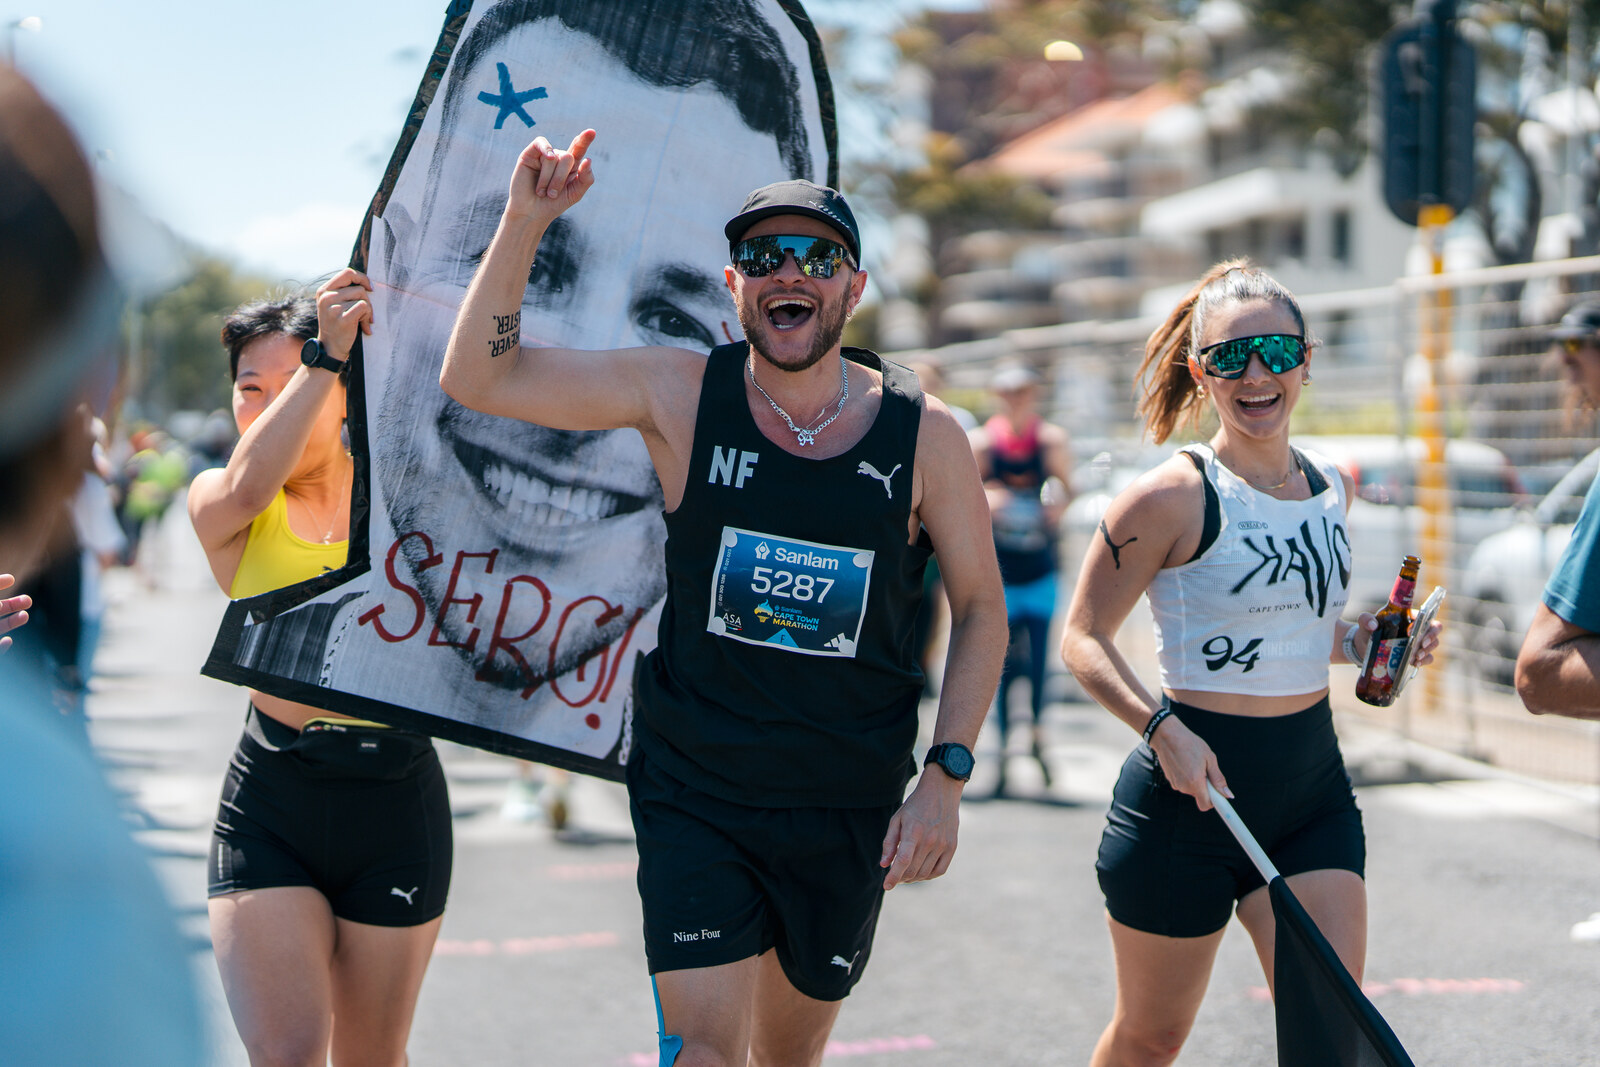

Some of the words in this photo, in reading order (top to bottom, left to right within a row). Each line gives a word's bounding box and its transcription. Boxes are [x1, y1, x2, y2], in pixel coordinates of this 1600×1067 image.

[708, 445, 759, 488] NF
[774, 547, 839, 570] Sanlam
[751, 566, 835, 604] 5287
[1249, 605, 1272, 613] CAPE
[1274, 603, 1302, 611] TOWN
[722, 612, 741, 625] ASA
[772, 618, 818, 631] MARATHON
[774, 612, 794, 620] CAPE
[796, 615, 819, 624] TOWN
[780, 634, 785, 643] F
[1202, 635, 1264, 673] 94
[673, 931, 699, 943] Nine
[701, 929, 721, 940] Four
